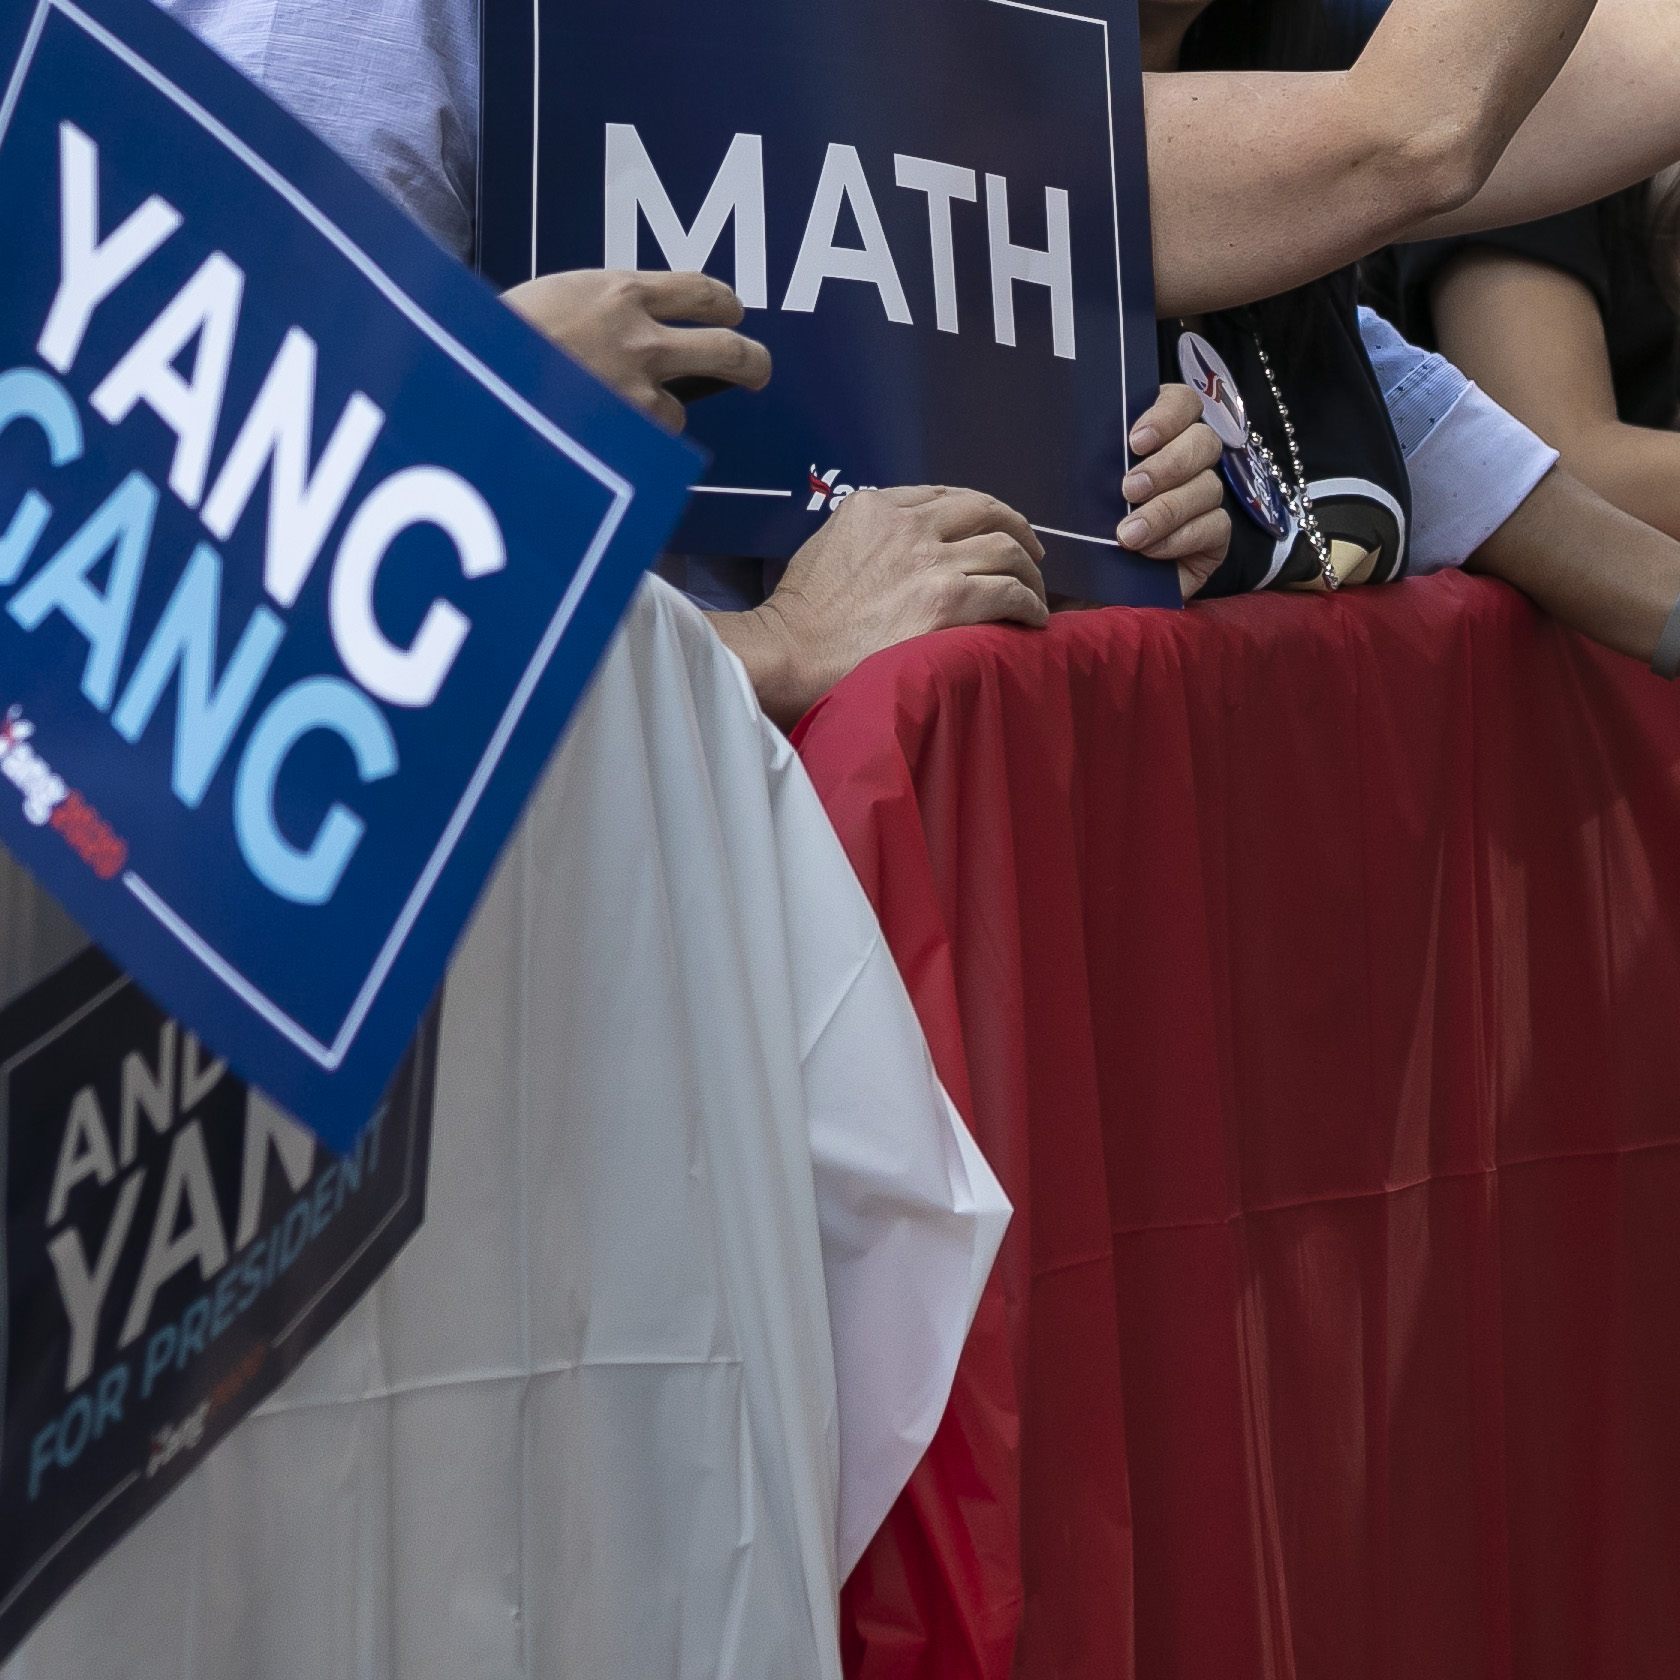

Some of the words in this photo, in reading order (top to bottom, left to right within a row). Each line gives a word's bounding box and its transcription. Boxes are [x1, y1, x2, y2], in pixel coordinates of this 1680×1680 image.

[604, 122, 1077, 360] MATH
[34, 119, 507, 709] YANG
[140, 1100, 389, 1401] PRESIDENT
[28, 1362, 131, 1503] FOR
